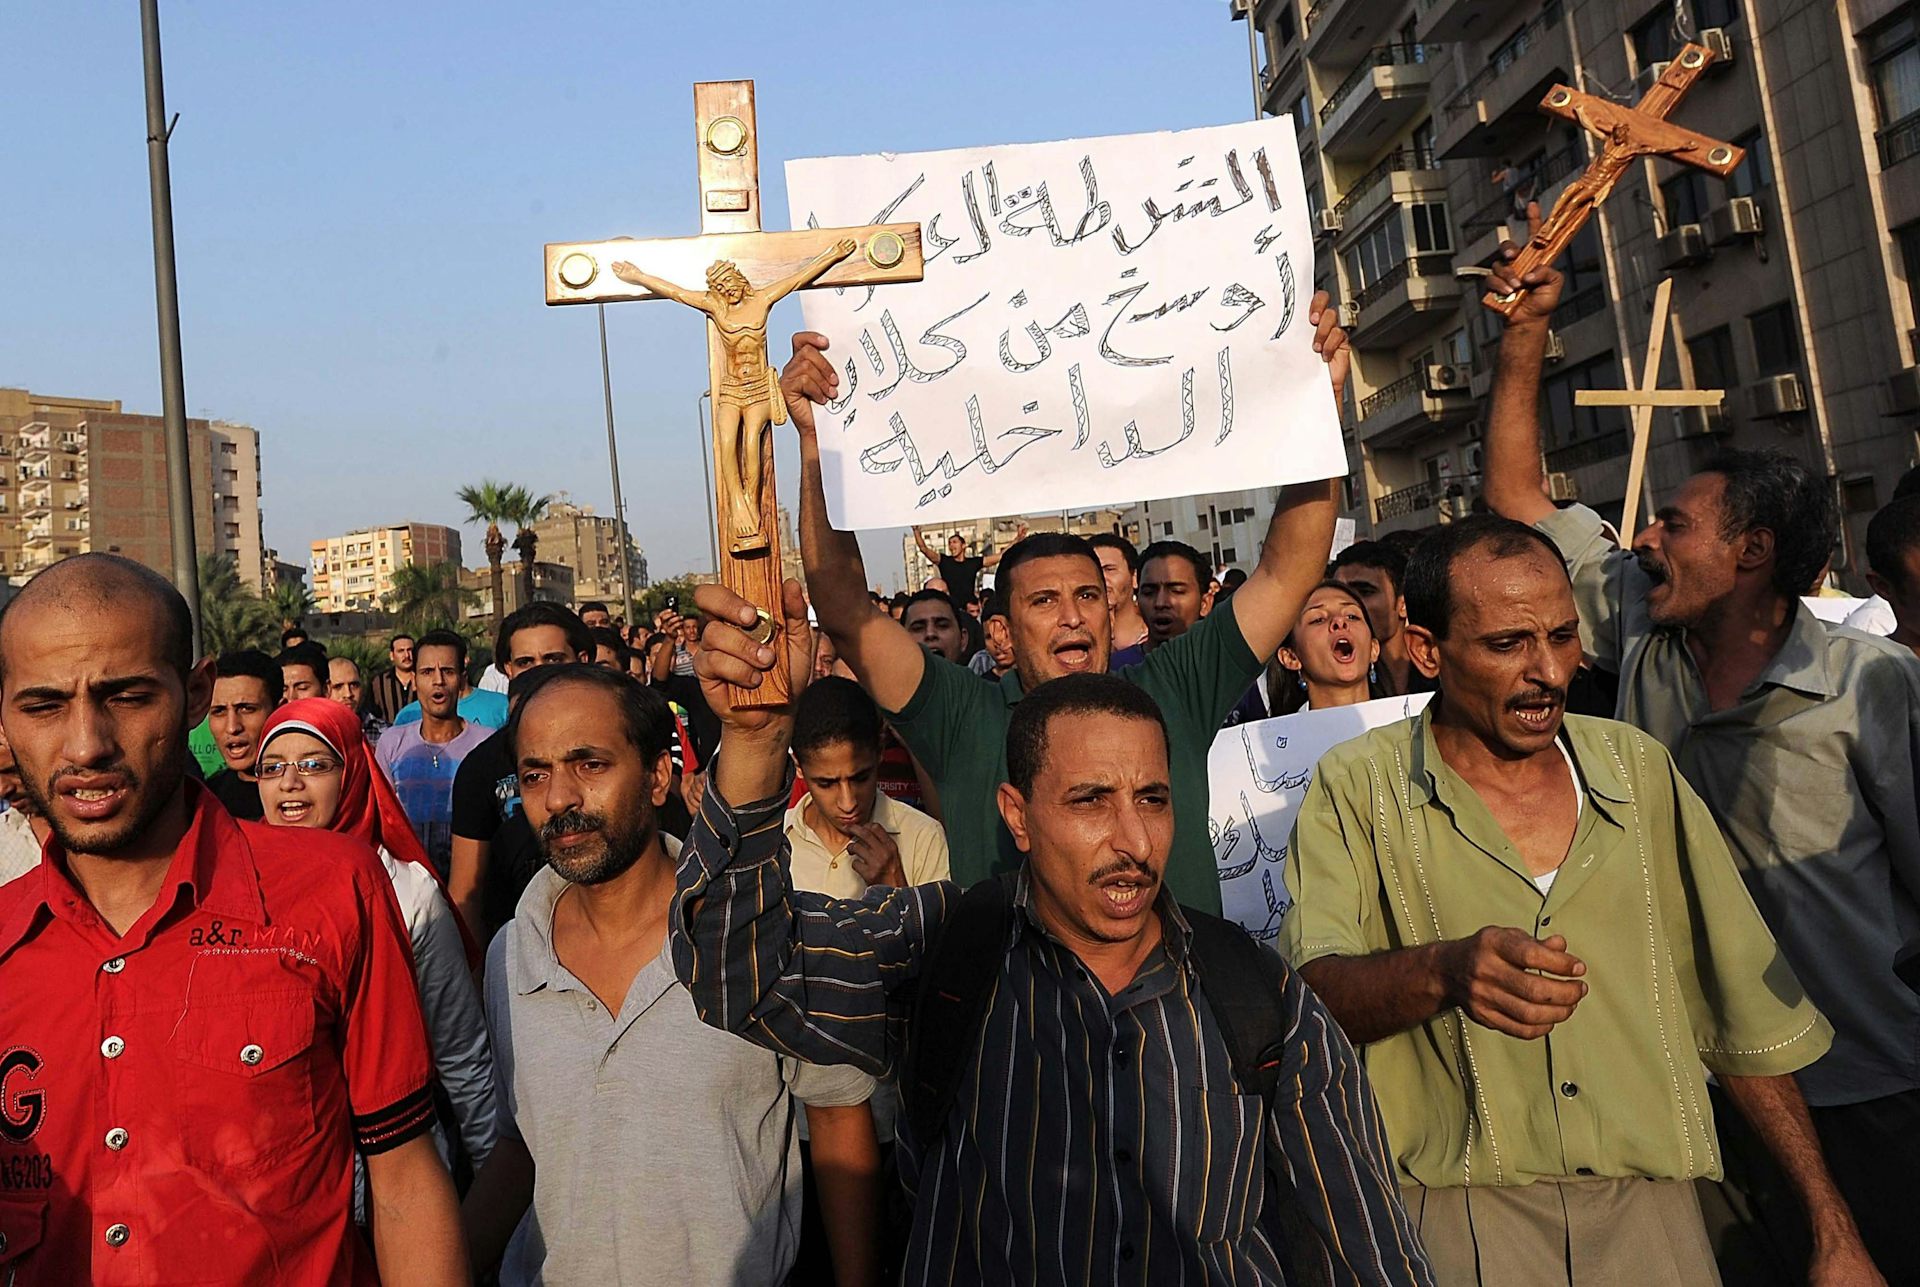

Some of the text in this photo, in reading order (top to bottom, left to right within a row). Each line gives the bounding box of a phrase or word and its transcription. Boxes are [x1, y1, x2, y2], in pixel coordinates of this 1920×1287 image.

[999, 146, 1282, 255] الشرطة
[999, 289, 1090, 373] من
[860, 346, 1231, 509] الداخلية
[880, 781, 909, 791] ERSITY
